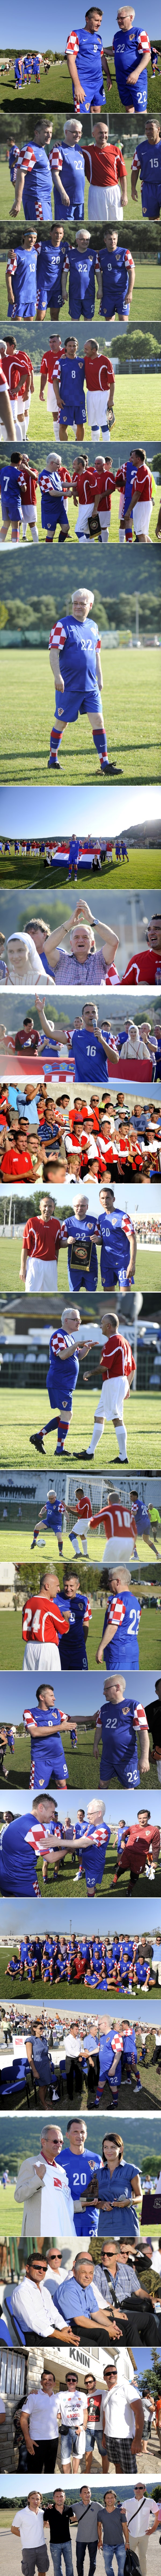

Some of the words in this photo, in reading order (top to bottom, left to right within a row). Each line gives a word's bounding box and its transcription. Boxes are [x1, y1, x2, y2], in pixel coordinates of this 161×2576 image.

[116, 44, 125, 52] 22
[103, 89, 105, 97] 9
[137, 91, 147, 103] 22
[74, 160, 83, 170] 22
[150, 158, 159, 168] 15
[29, 264, 35, 272] 13
[3, 476, 10, 491] 7
[81, 639, 93, 651] 22
[86, 1046, 96, 1056] 16
[76, 1233, 86, 1241] 22
[102, 1228, 110, 1237] 20
[118, 1270, 127, 1279] 20
[141, 1505, 148, 1515] 20
[115, 1511, 130, 1527] 10
[23, 1608, 41, 1633] 24
[70, 1612, 75, 1621] 9
[83, 1658, 87, 1667] 9
[105, 1718, 117, 1728] 22
[63, 1764, 67, 1773] 9
[127, 1770, 138, 1782] 22
[73, 2173, 86, 2185] 20
[69, 2347, 90, 2368] KNIN
